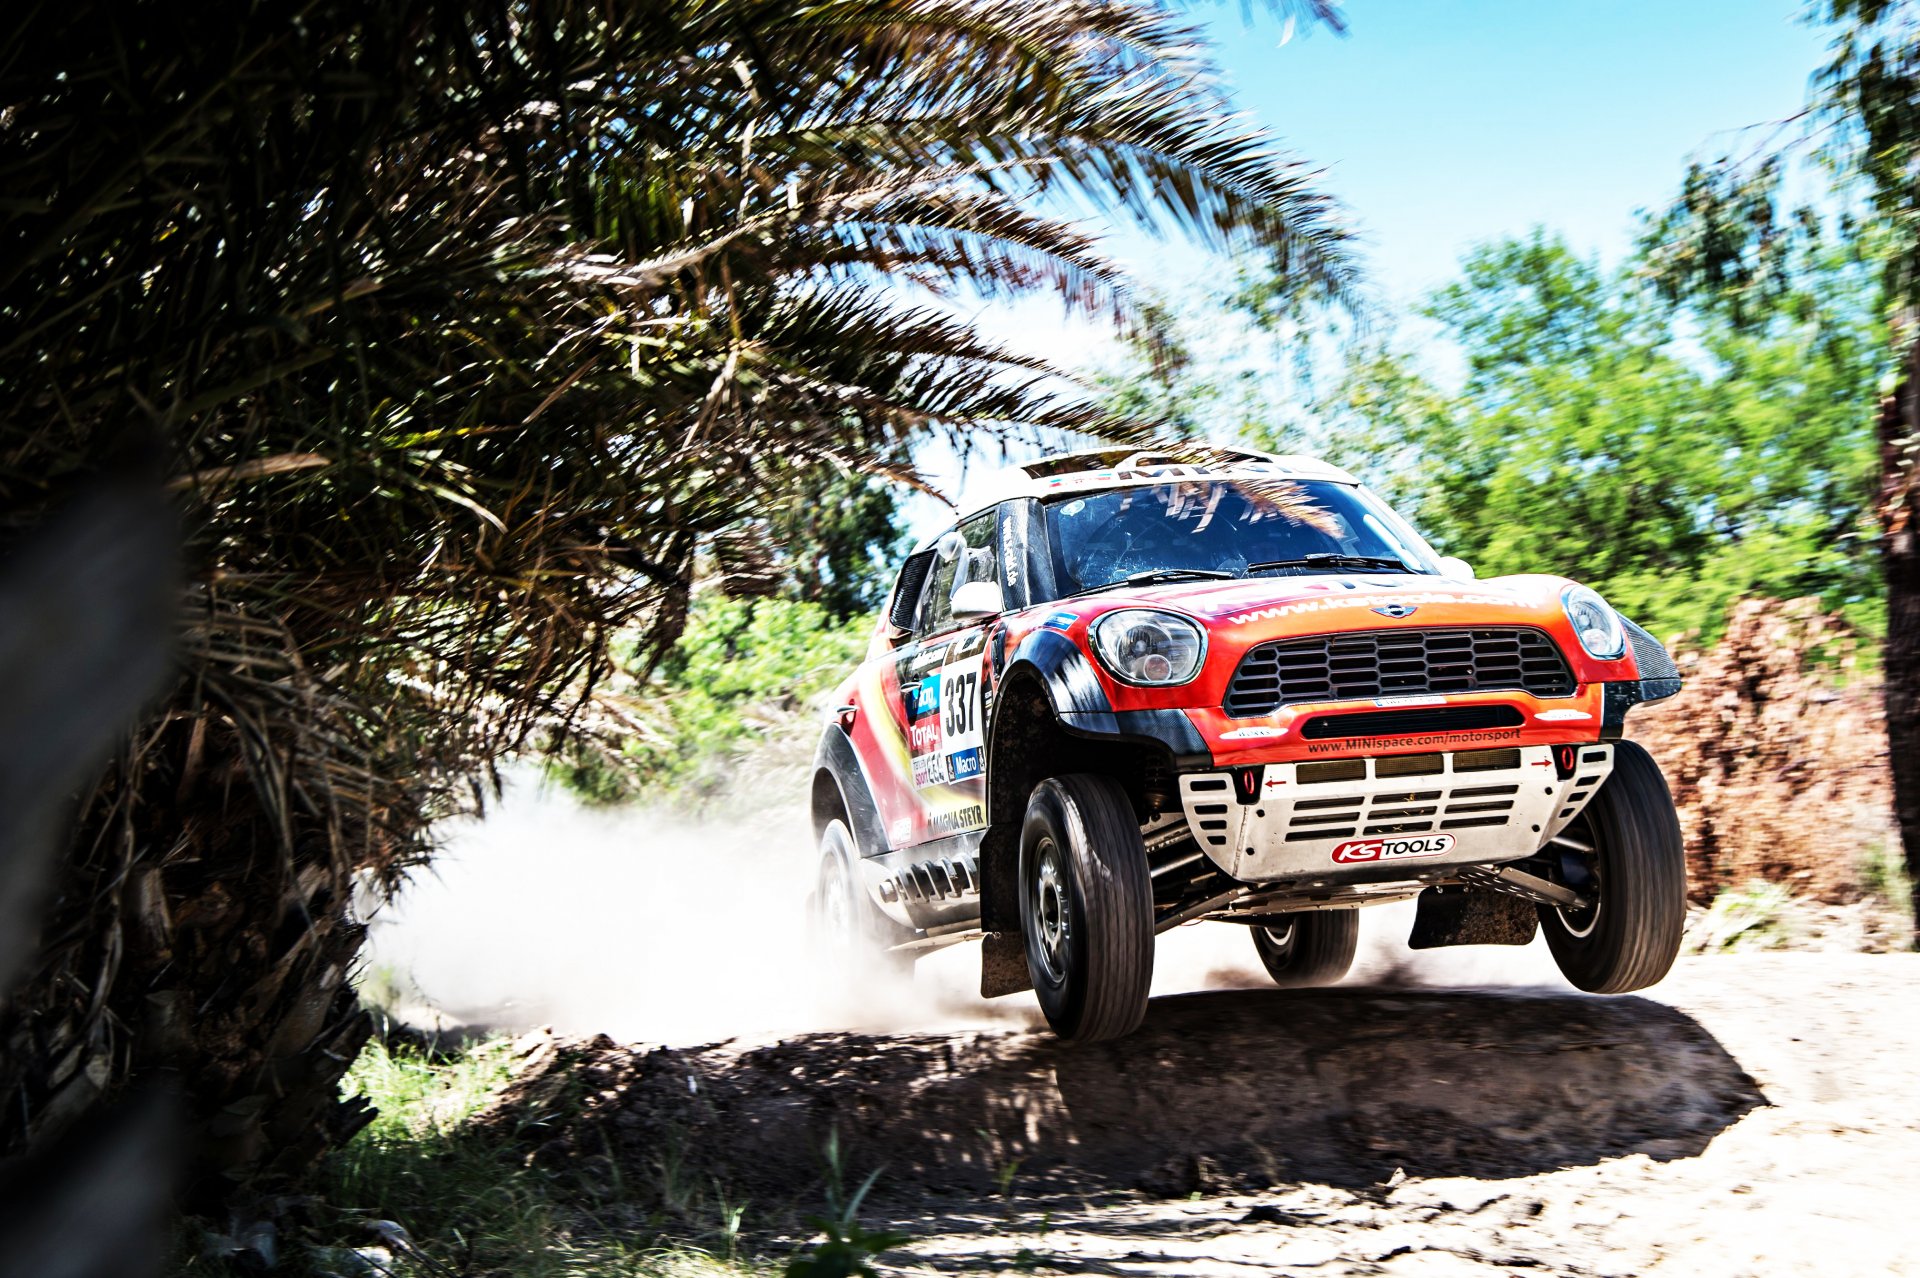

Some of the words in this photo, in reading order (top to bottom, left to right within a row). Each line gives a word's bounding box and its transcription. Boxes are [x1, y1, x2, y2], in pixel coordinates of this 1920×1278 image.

[945, 672, 977, 737] 337
[955, 756, 977, 775] Macro
[933, 811, 960, 834] MAGNA
[960, 805, 984, 829] STEYR
[1338, 843, 1382, 861] KS
[1382, 838, 1446, 855] TOOLS
